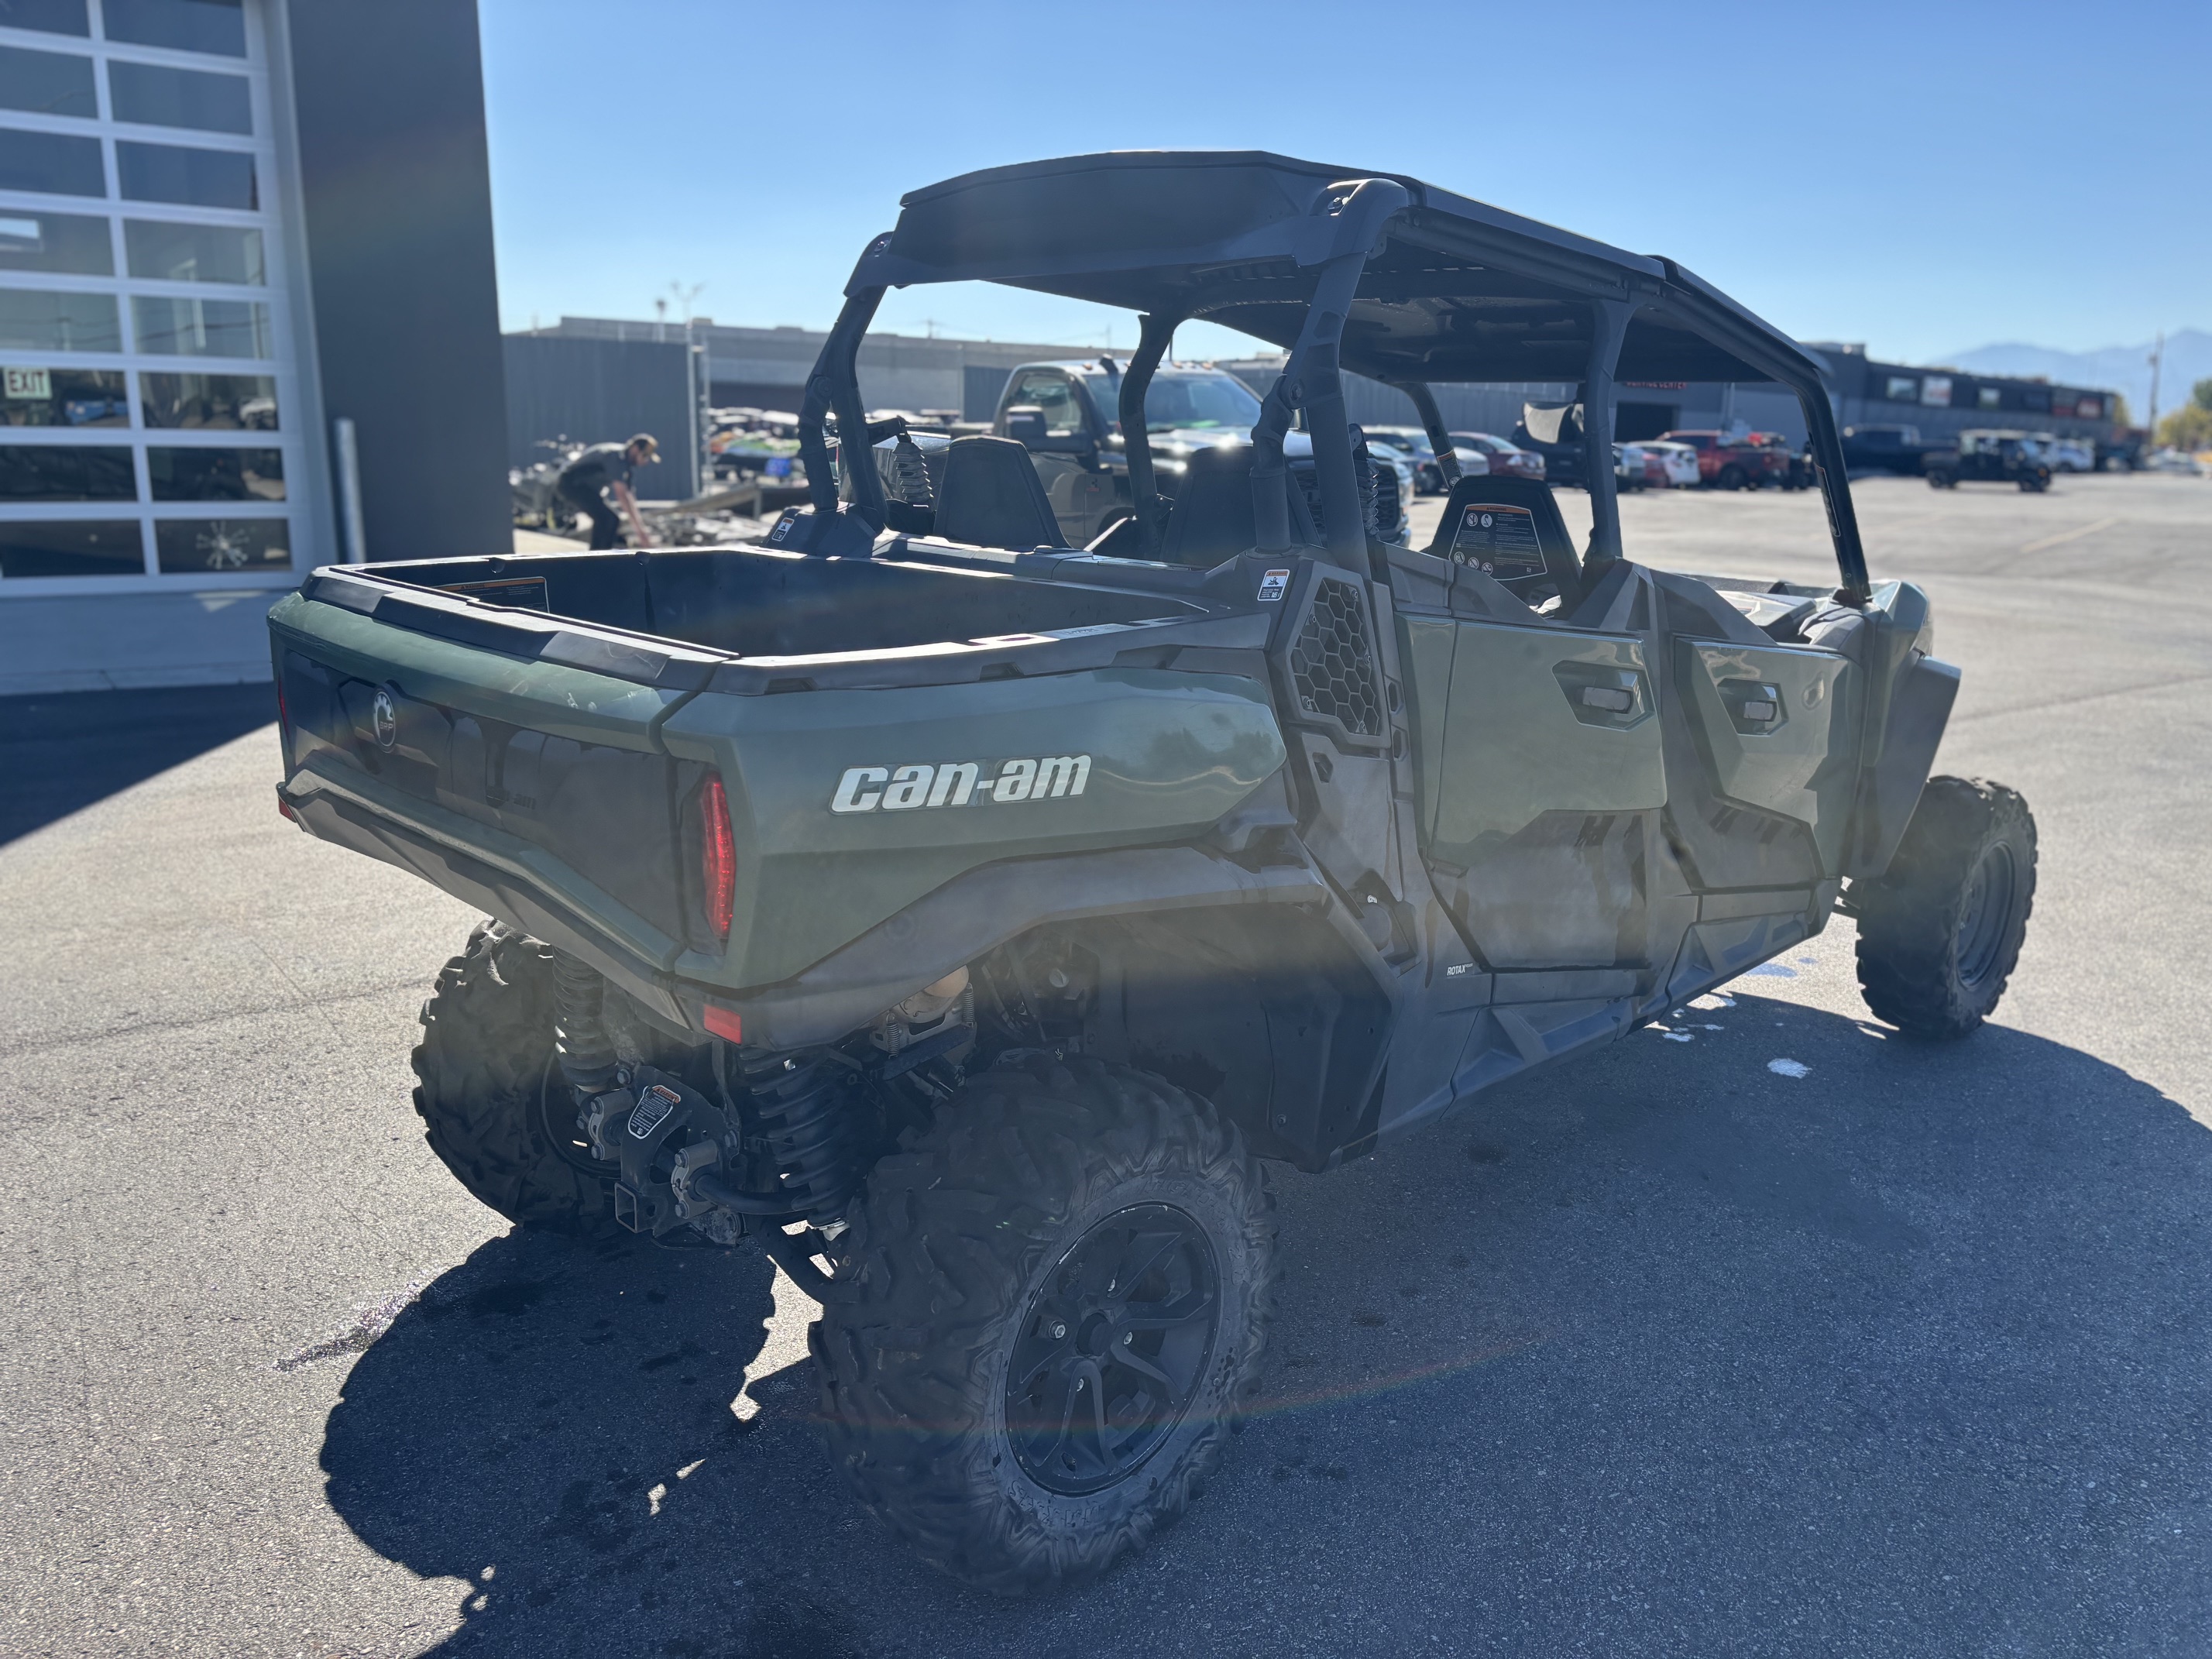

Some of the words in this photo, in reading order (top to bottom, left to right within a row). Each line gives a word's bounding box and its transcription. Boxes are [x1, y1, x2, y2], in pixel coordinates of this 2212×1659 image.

[9, 371, 44, 392] EXIT
[379, 720, 394, 731] BRP
[1447, 964, 1465, 976] ROTAX
